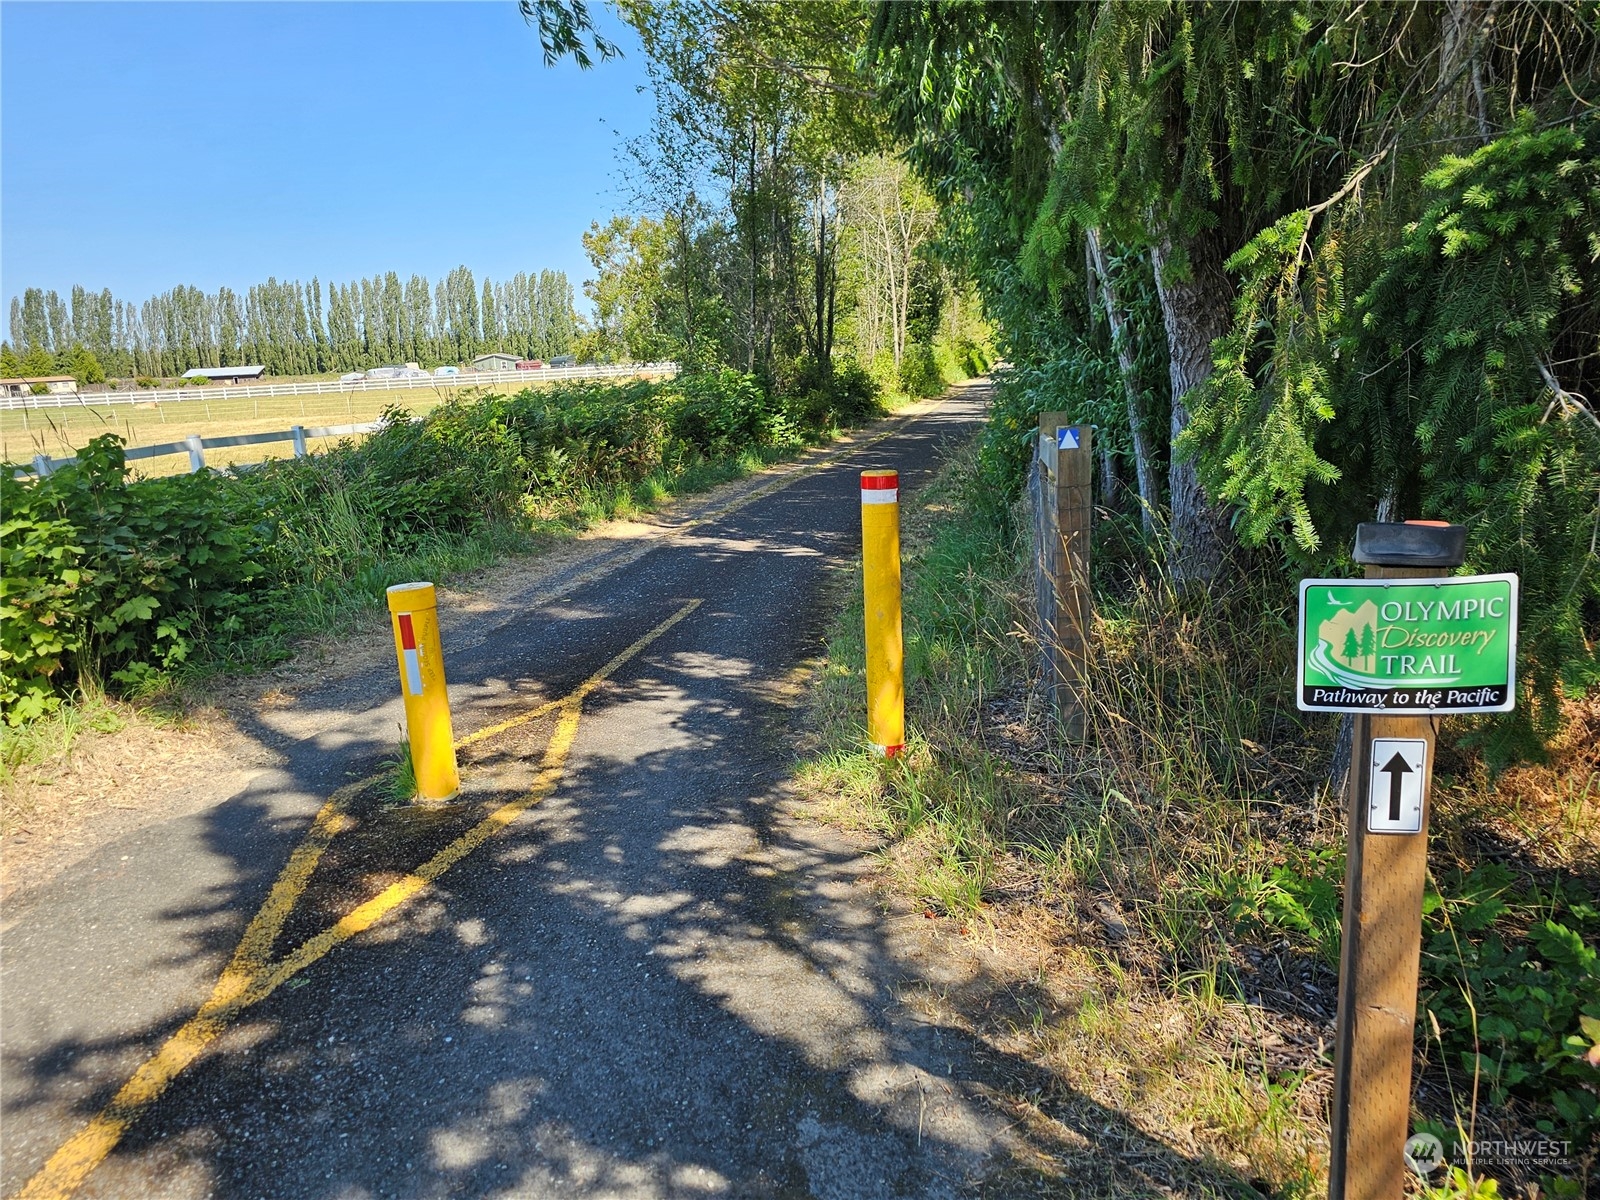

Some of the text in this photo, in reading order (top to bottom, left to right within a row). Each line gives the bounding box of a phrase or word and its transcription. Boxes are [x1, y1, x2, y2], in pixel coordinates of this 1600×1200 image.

[1381, 597, 1504, 622] OLYMPIC
[1376, 624, 1496, 655] Discovery
[1381, 654, 1461, 675] TRAIL
[1313, 687, 1500, 708] Pathway to the Pacific
